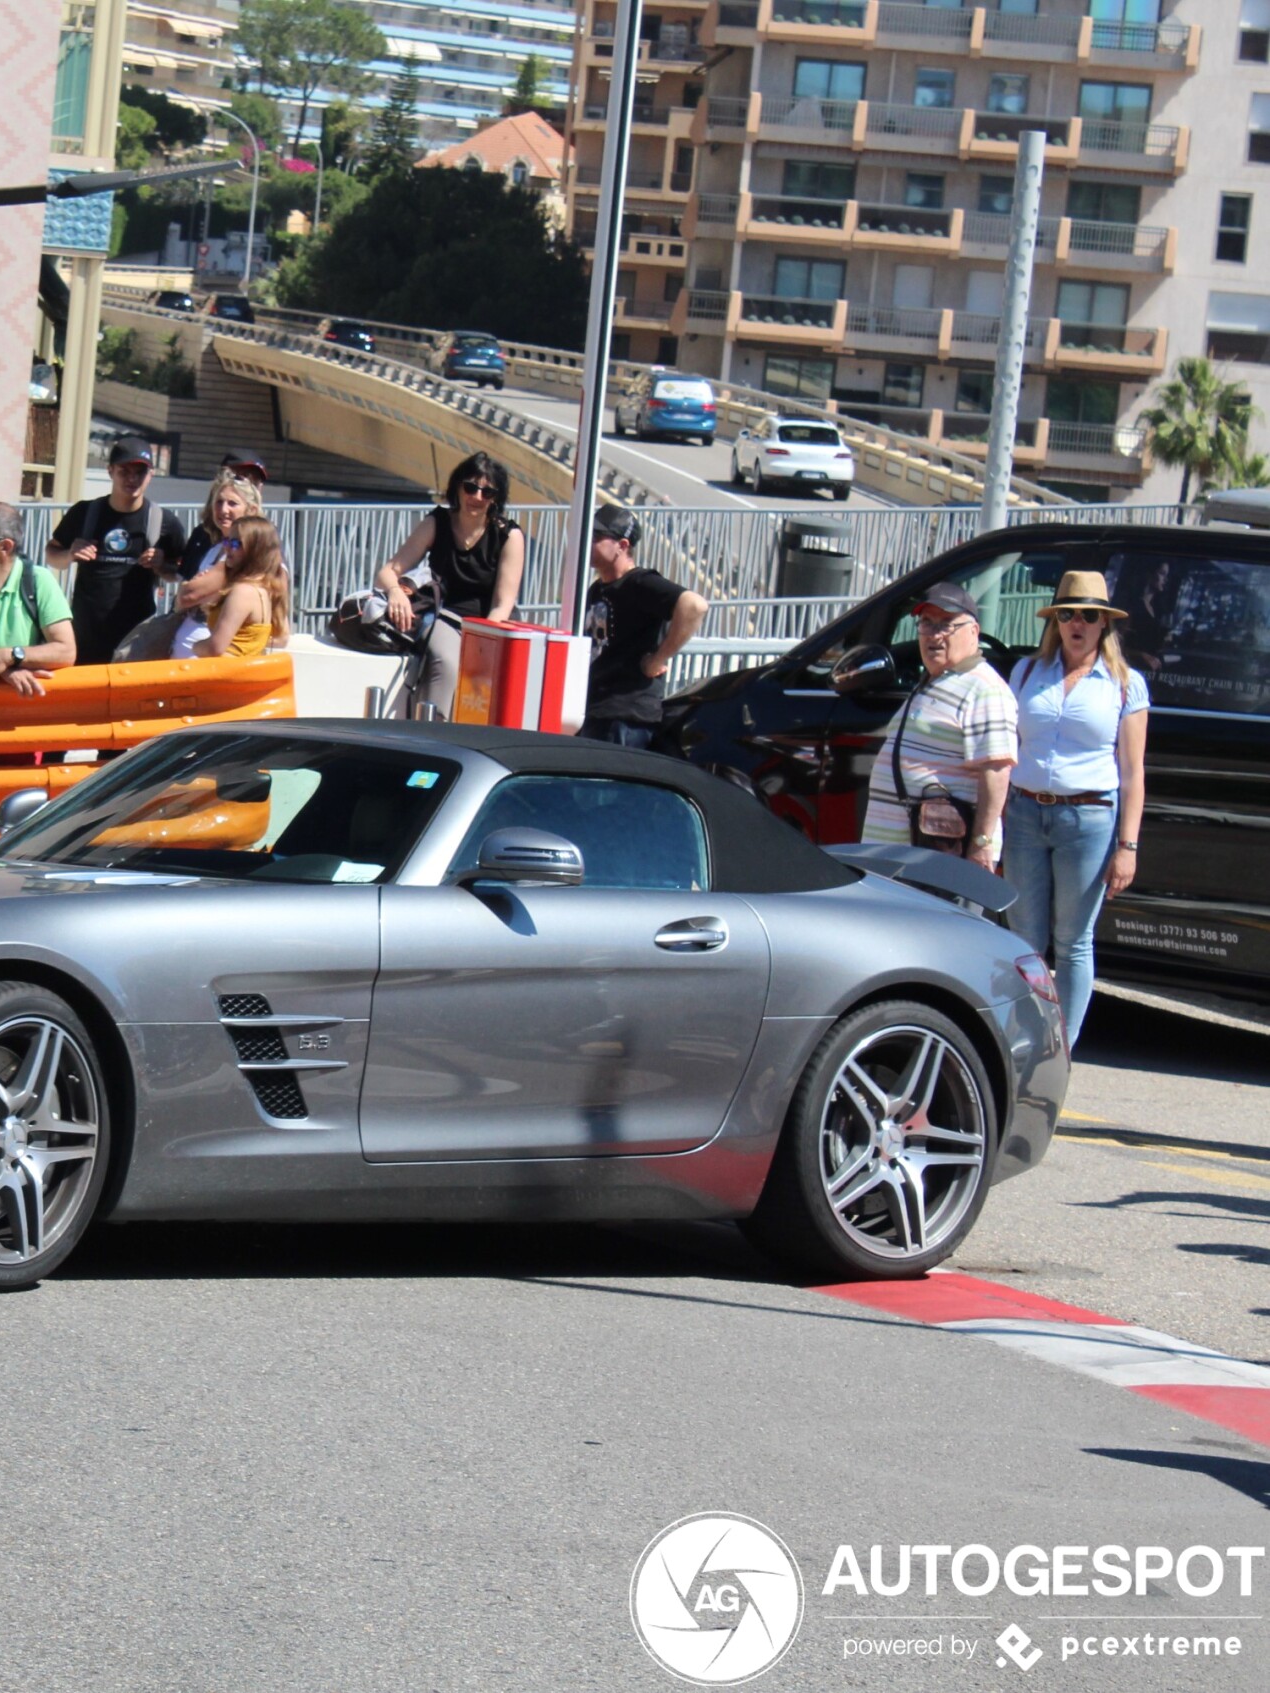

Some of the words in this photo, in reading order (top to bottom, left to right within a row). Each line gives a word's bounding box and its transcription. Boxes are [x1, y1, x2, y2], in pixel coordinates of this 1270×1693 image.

[1158, 672, 1206, 687] RESTAURANT
[1208, 677, 1233, 690] CHAIN
[1115, 918, 1157, 934] Bookings:
[1160, 924, 1183, 937] (377)
[1186, 927, 1198, 938] 93
[1221, 932, 1238, 943] 500
